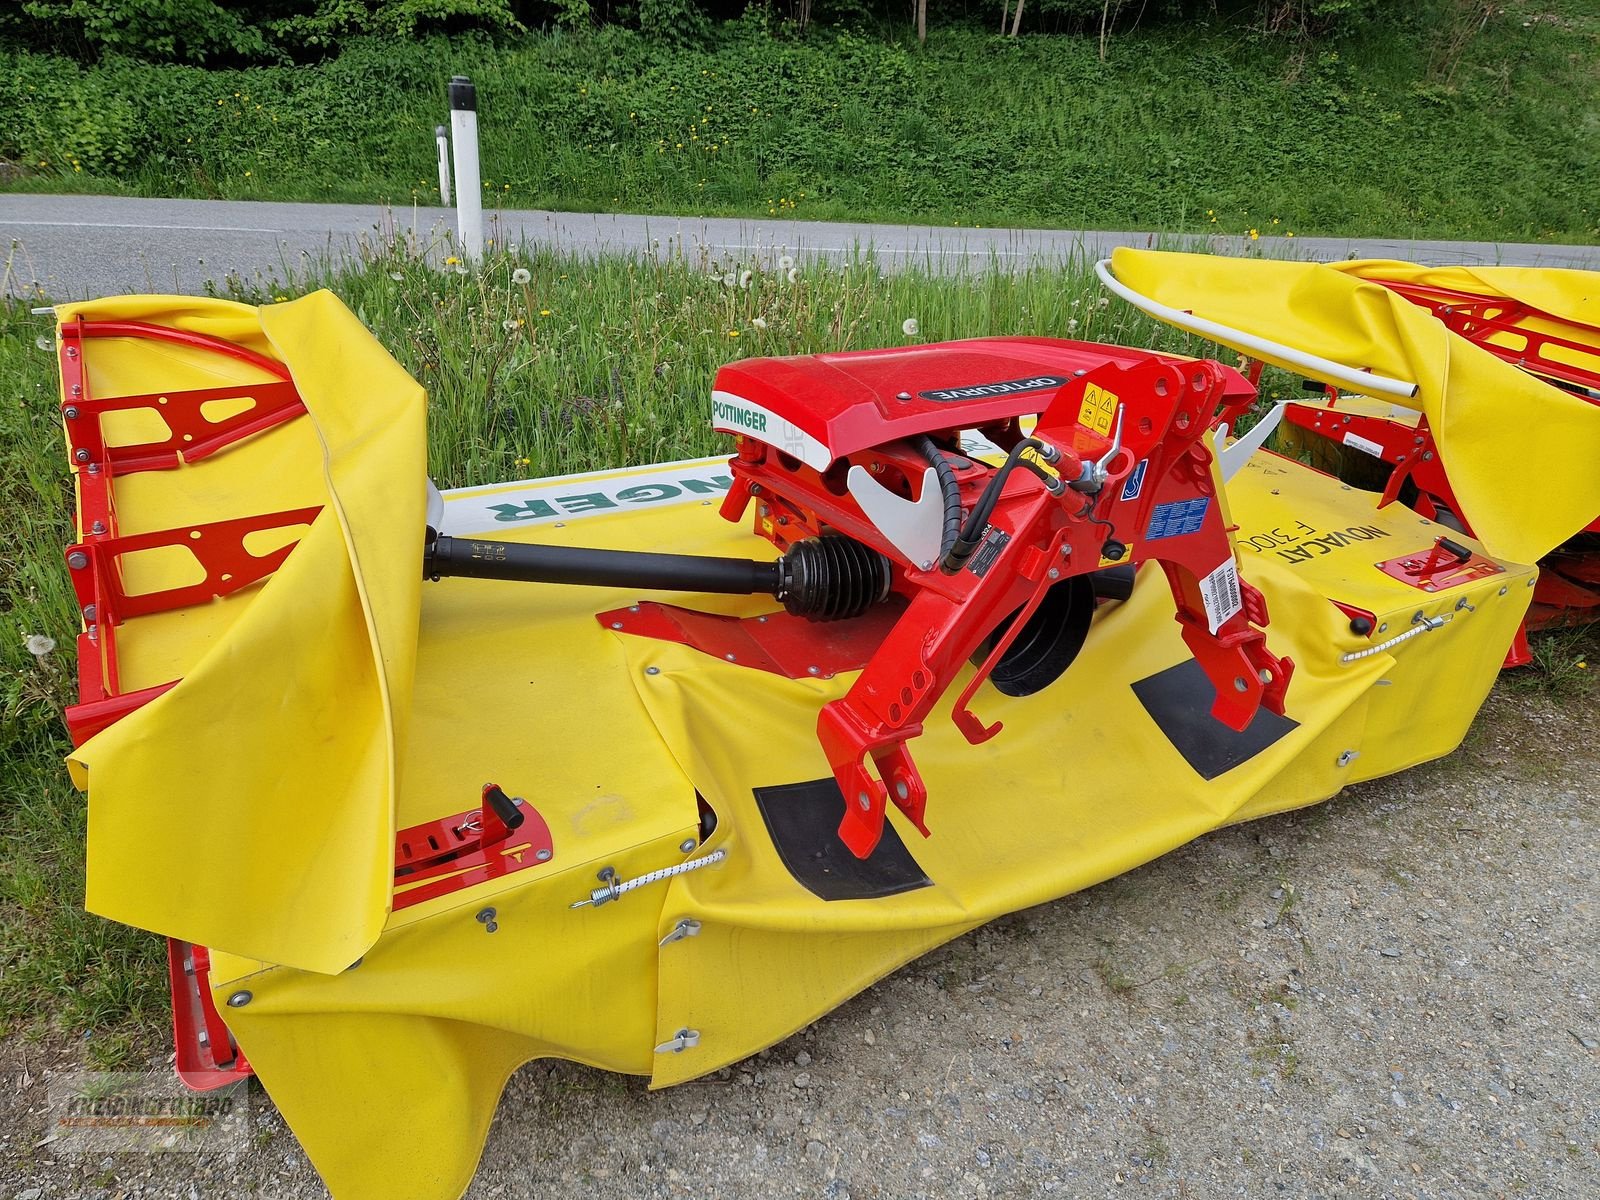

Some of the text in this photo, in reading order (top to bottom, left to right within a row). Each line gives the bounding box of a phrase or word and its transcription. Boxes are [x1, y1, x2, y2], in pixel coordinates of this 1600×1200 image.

[932, 378, 1056, 400] OPTICURVE
[1295, 520, 1316, 536] F
[1276, 525, 1391, 564] NOVACAT
